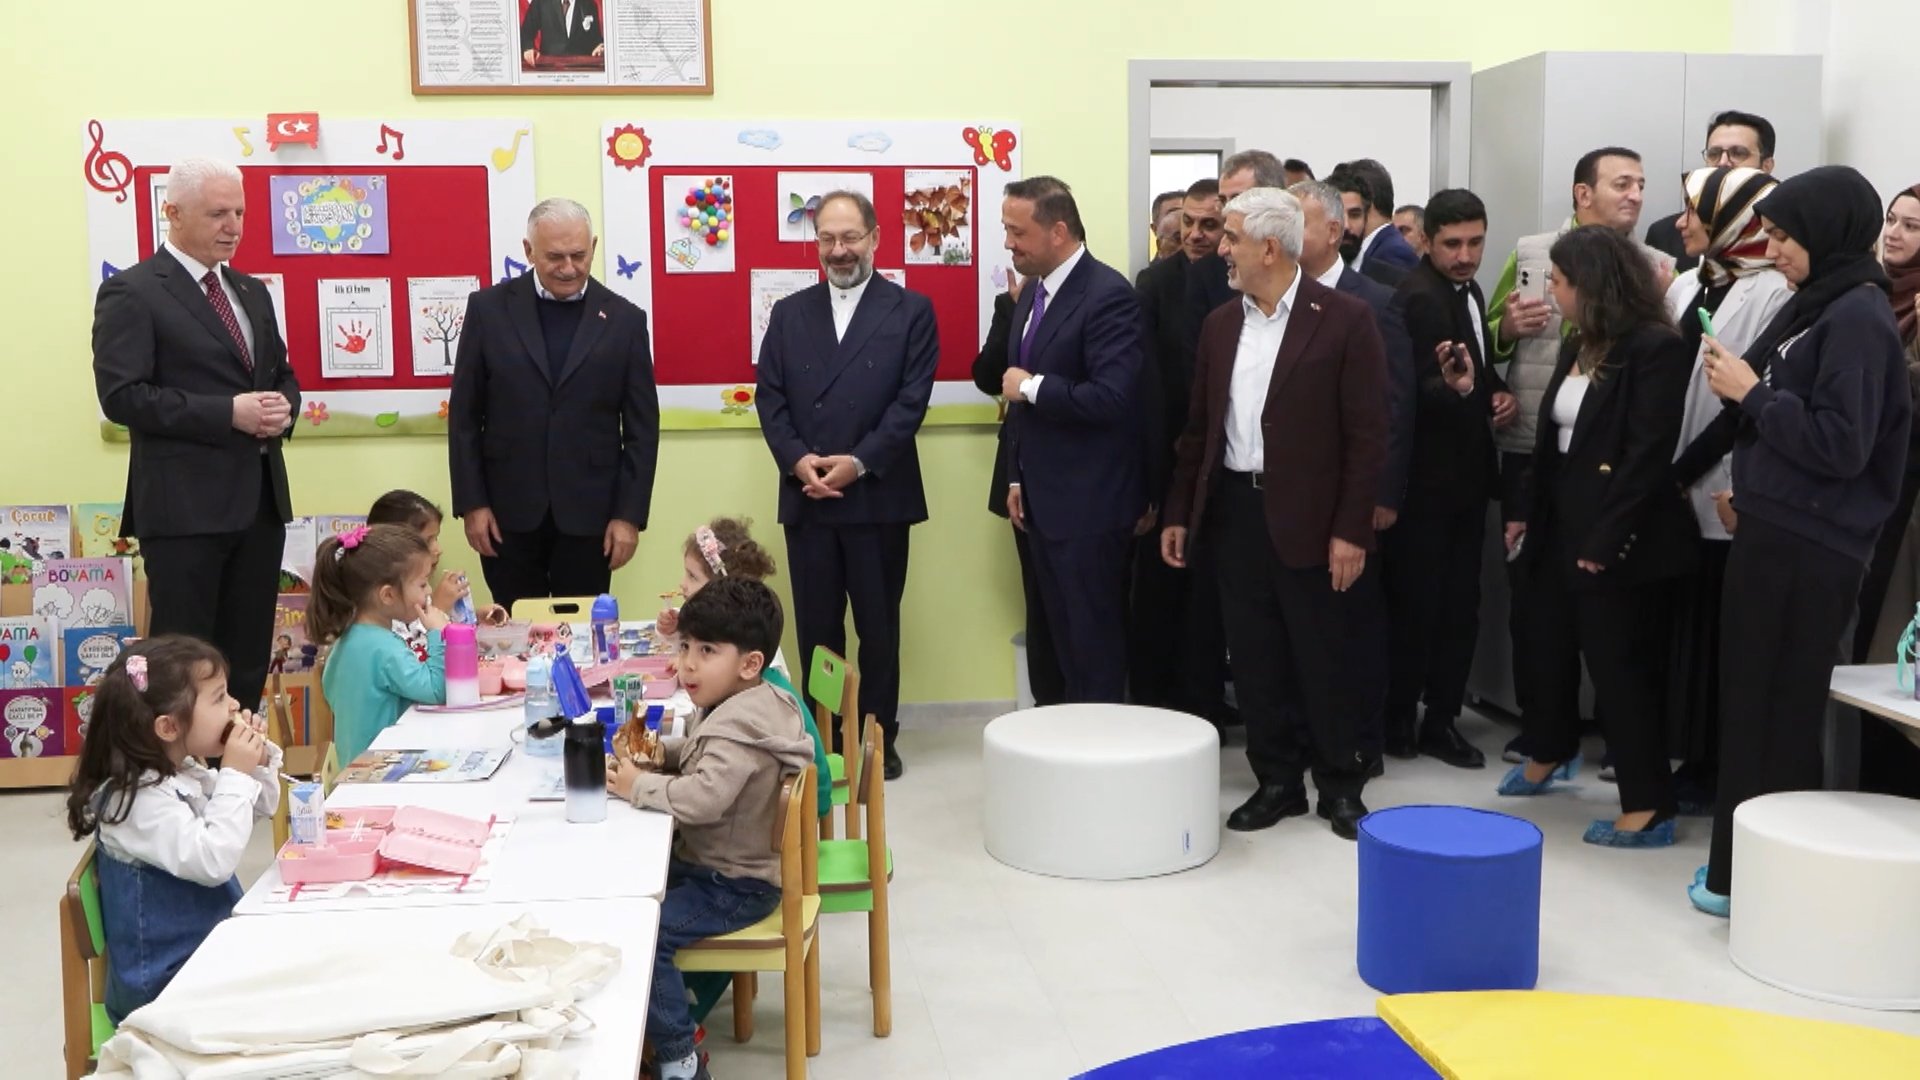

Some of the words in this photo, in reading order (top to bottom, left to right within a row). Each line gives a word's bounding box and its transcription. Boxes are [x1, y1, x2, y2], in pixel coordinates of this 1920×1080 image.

[10, 508, 57, 526] Çocuk
[48, 568, 114, 583] BOYAMA
[0, 626, 39, 641] AMA
